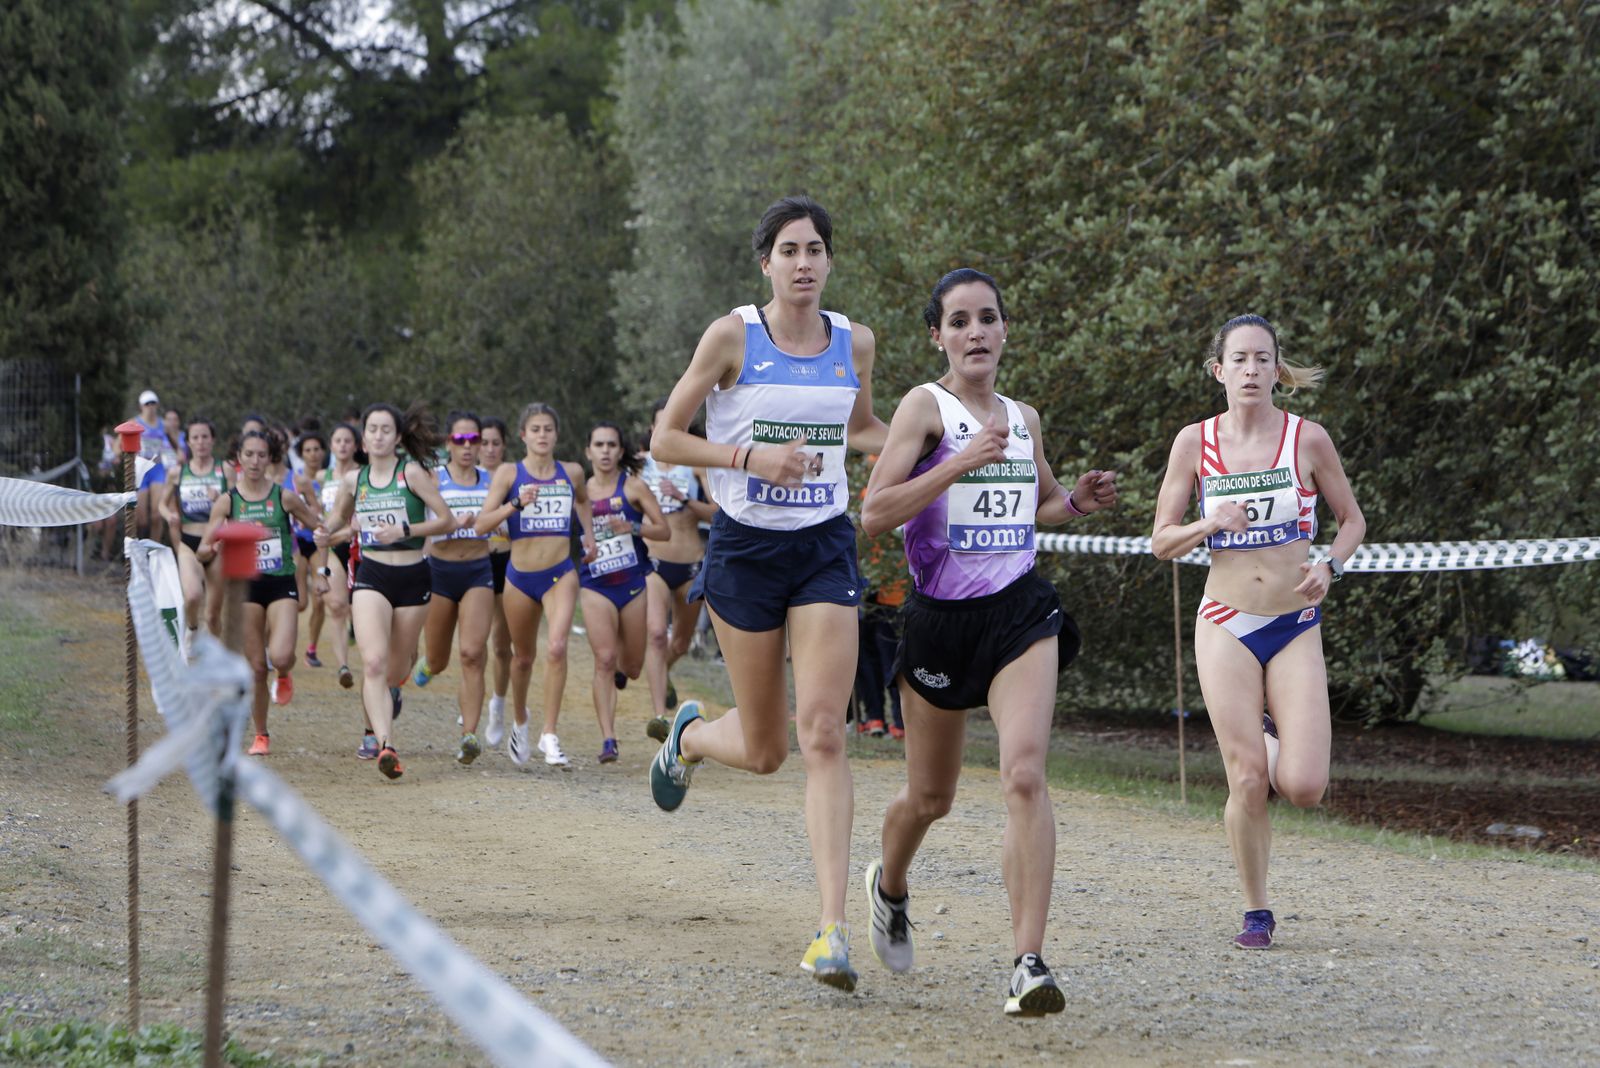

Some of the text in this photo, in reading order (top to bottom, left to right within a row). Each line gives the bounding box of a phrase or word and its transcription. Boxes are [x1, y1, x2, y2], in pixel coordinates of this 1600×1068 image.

[754, 423, 844, 440] DIPUTACION DE SEVILLA
[1001, 464, 1011, 477] DE
[1012, 463, 1036, 477] SEVILLA
[1206, 470, 1292, 492] DIPUTACION DE SEVILLA
[534, 500, 563, 515] 512
[973, 490, 1022, 518] 437
[960, 528, 1025, 549] Joma
